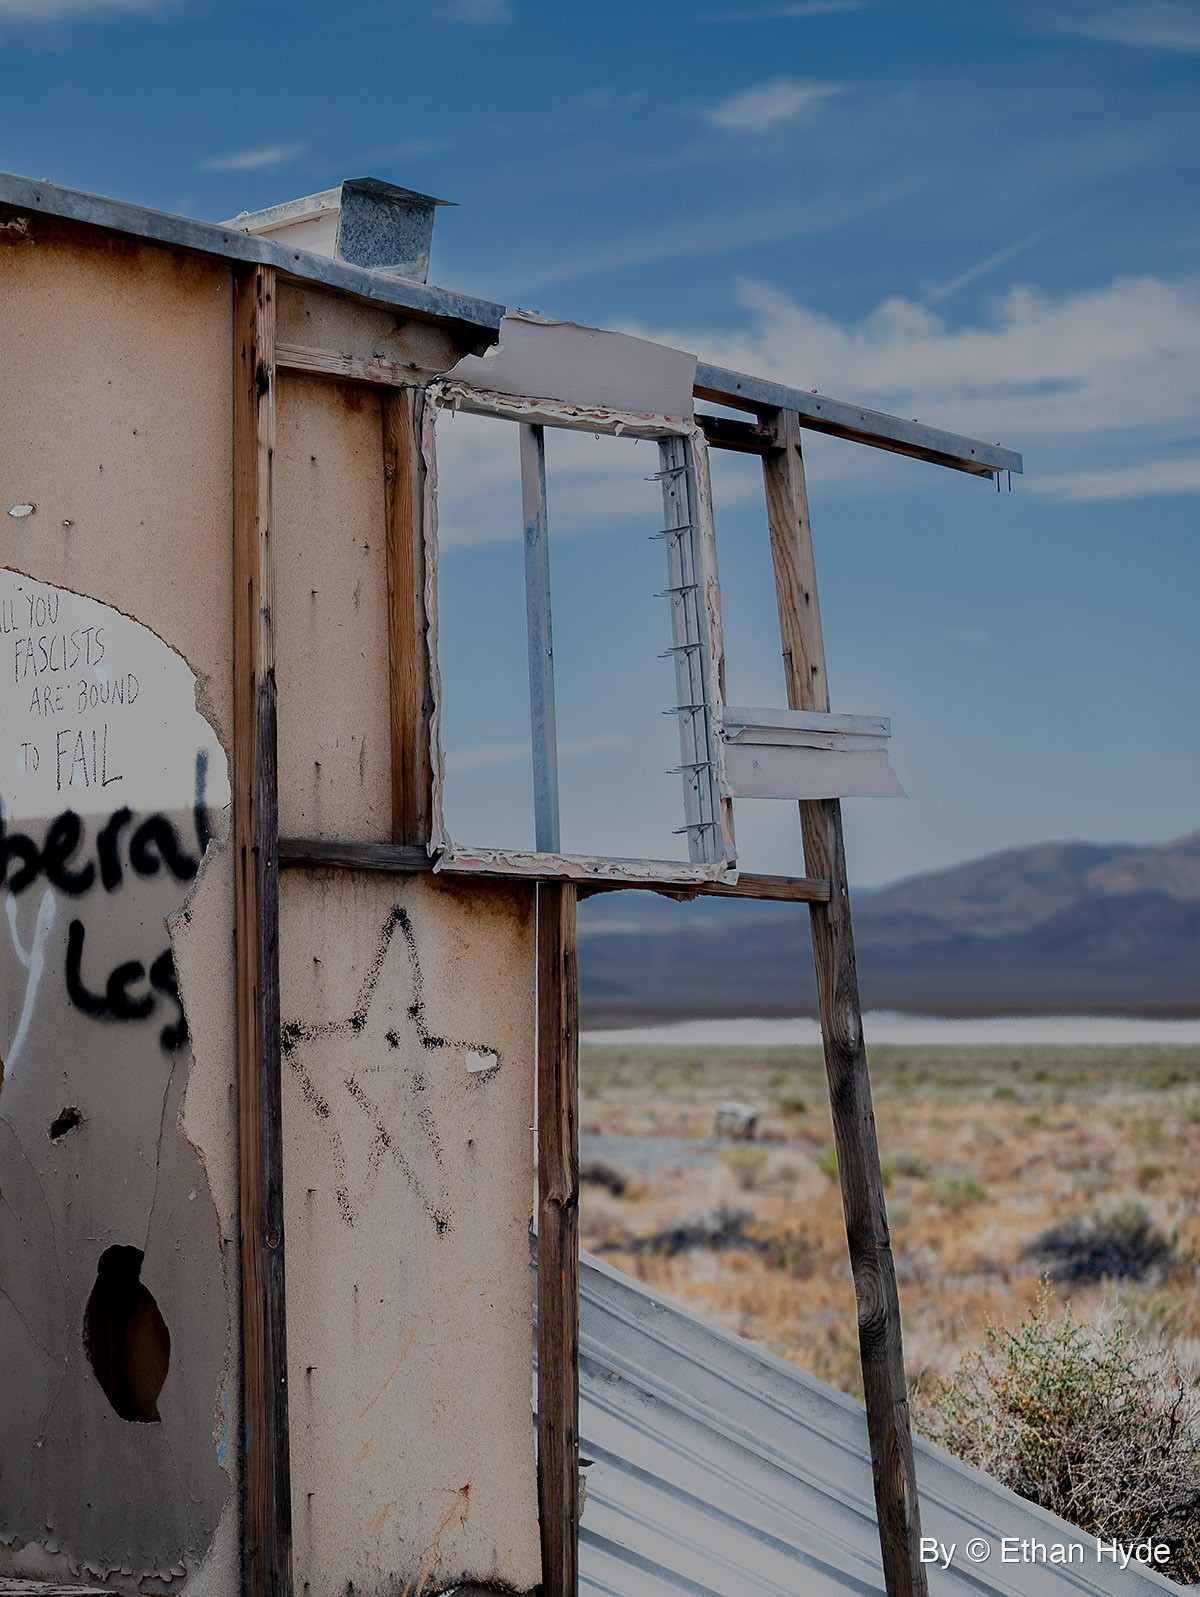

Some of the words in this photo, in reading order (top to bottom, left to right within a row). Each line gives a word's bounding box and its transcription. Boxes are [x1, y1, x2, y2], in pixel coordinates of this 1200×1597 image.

[26, 593, 60, 629] YOU
[14, 627, 106, 683] FASCISTS
[29, 685, 65, 717] ARE
[77, 673, 140, 715] BOUND
[21, 742, 41, 773] TO
[55, 723, 124, 794] FAIL
